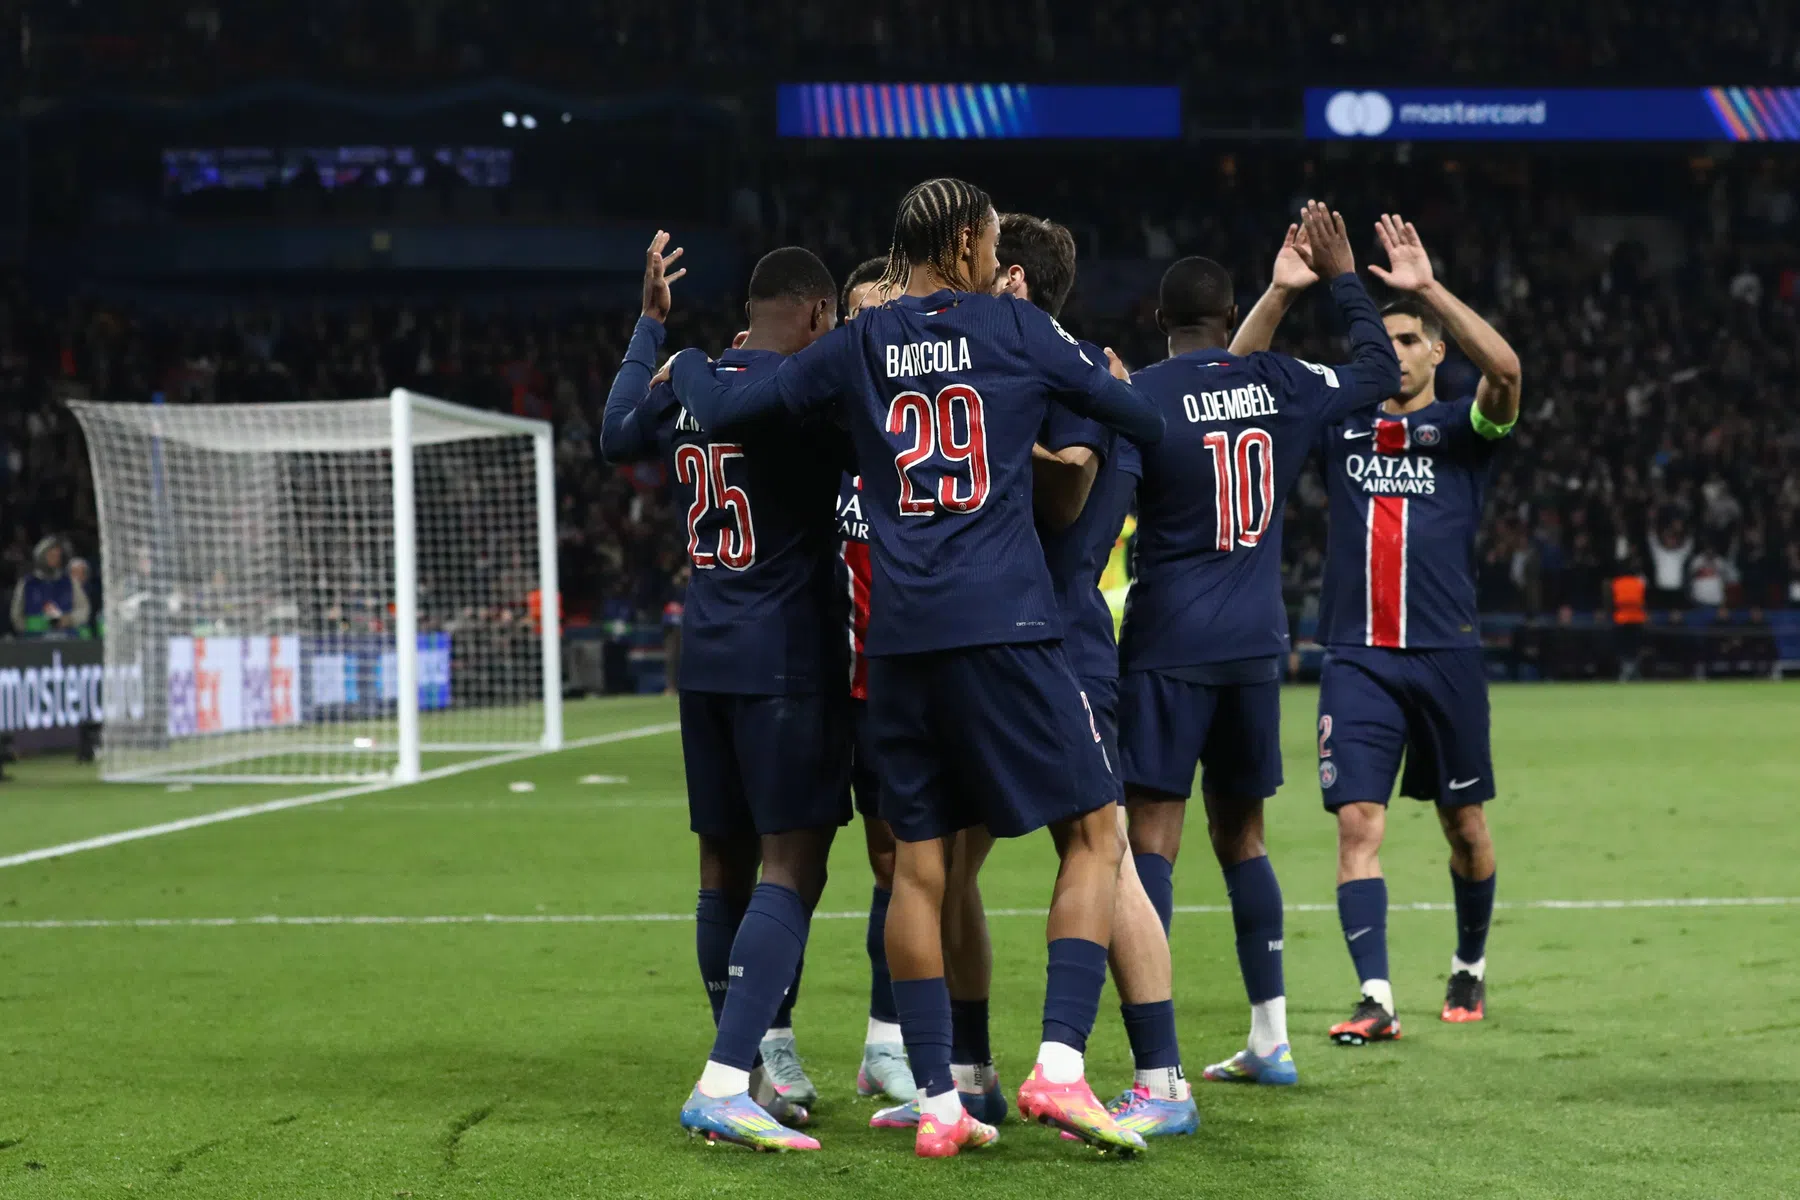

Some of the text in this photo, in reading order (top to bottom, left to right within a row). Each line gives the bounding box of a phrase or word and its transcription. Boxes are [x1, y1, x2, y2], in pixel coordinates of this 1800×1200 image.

[1400, 99, 1546, 124] mastercard
[886, 337, 972, 378] BARCOLA
[886, 384, 990, 517] 29
[1346, 454, 1435, 482] QATAR
[675, 443, 756, 572] 25
[1203, 428, 1275, 552] 10
[1362, 478, 1436, 495] AIRWAYS
[1319, 714, 1333, 758] 2
